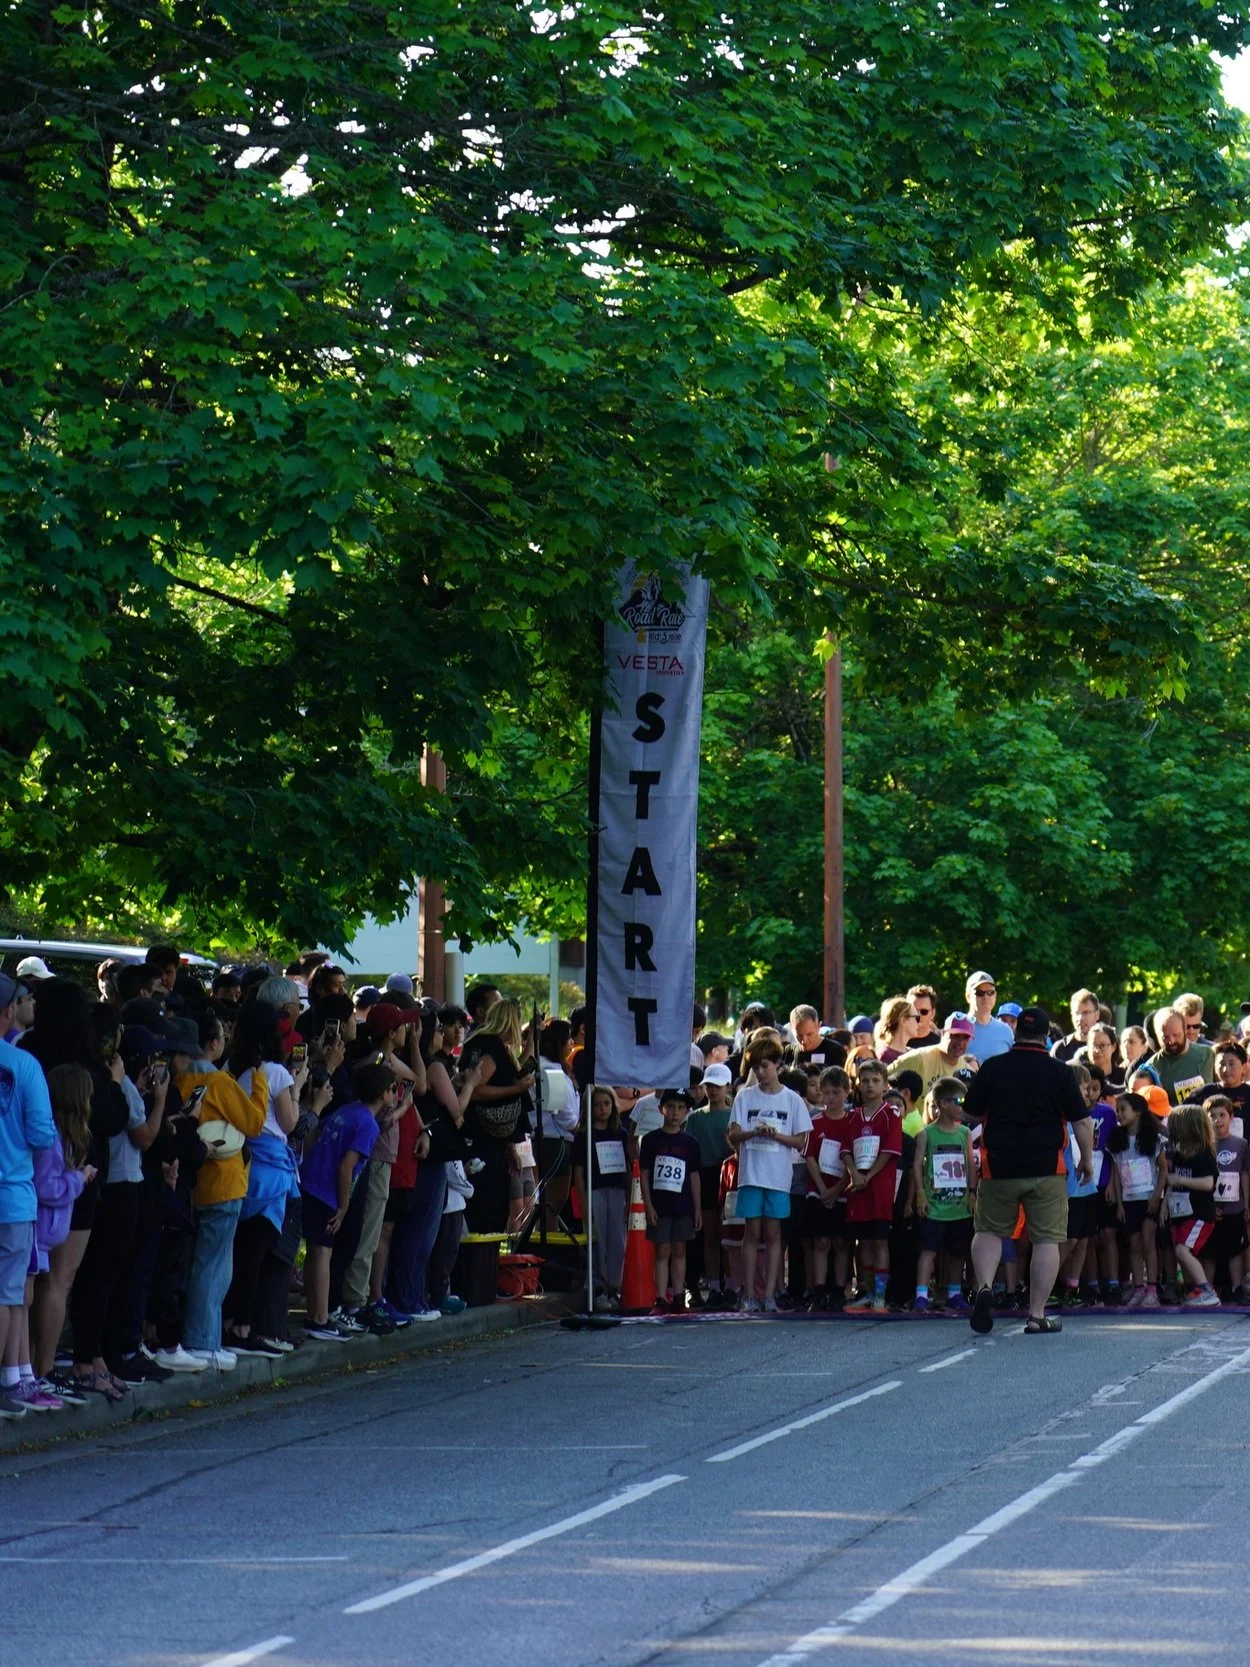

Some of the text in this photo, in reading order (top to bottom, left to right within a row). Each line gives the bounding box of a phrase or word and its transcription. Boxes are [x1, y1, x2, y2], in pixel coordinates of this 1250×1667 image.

[623, 606, 684, 628] Road Race
[617, 655, 684, 670] VESTA
[621, 692, 666, 1046] START
[657, 1164, 682, 1180] 738
